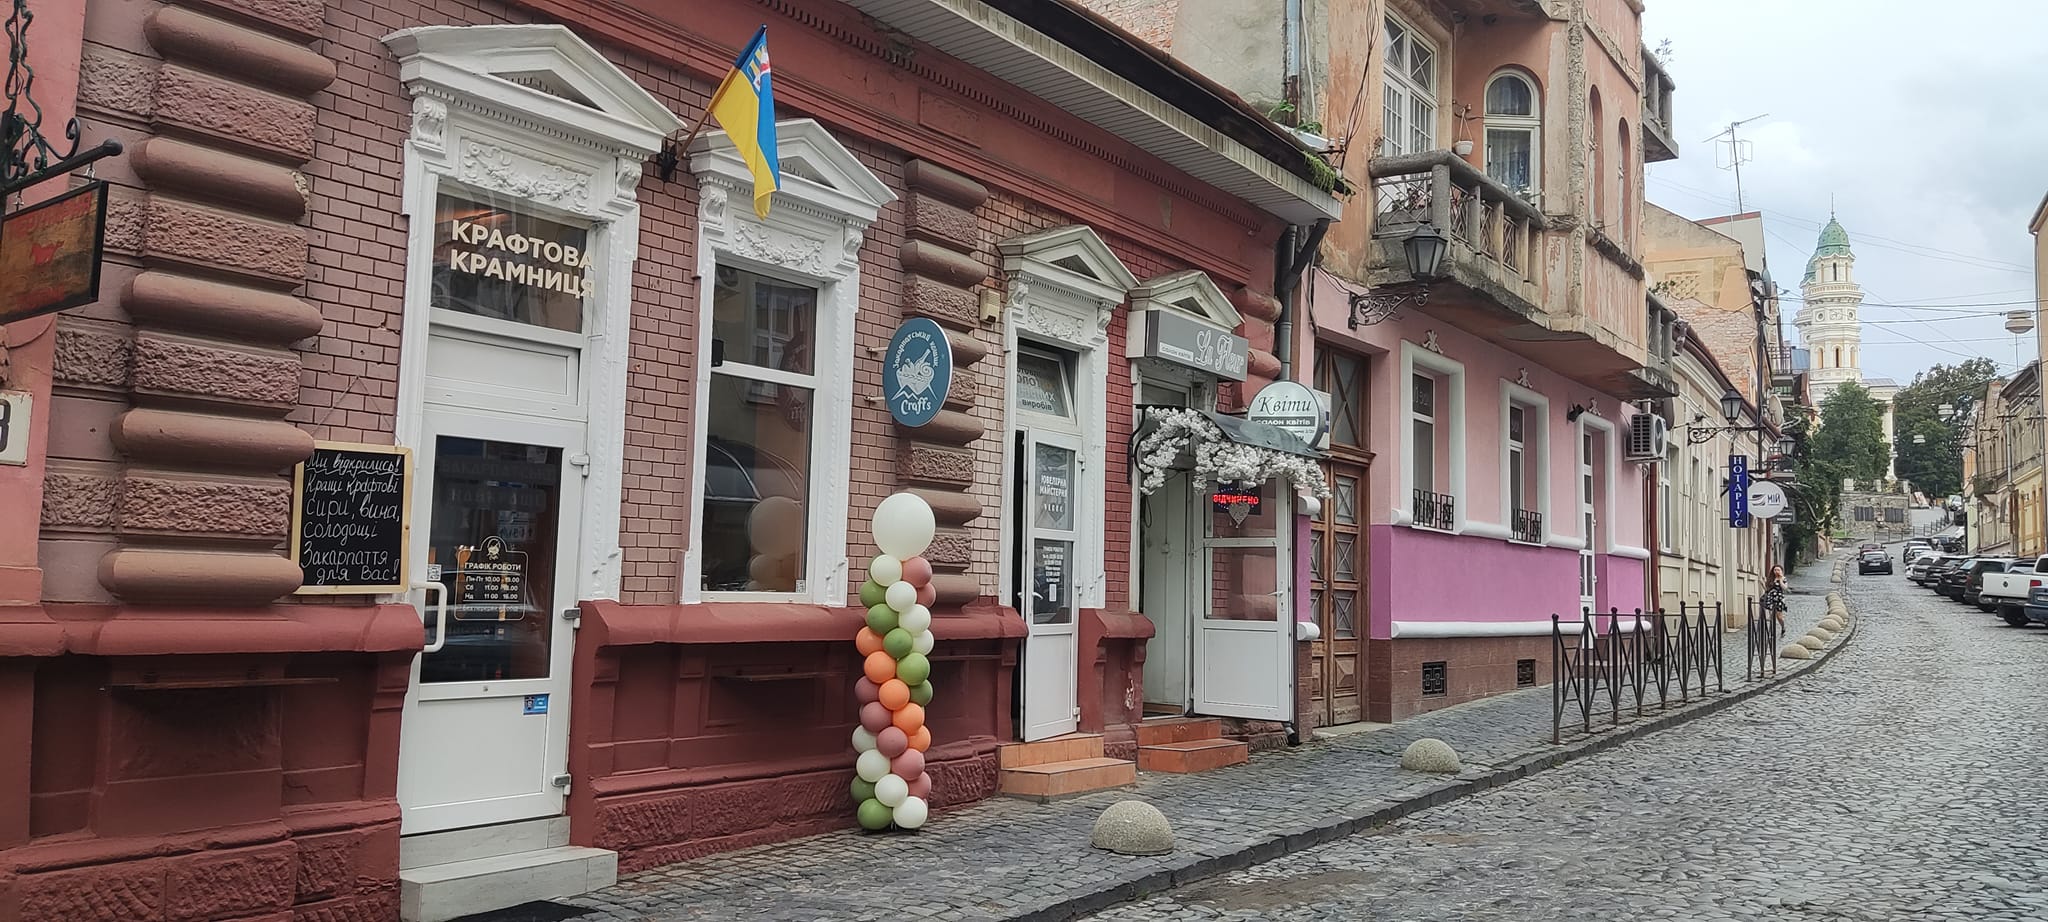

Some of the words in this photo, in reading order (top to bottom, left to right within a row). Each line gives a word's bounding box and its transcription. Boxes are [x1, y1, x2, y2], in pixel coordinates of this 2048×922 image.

[451, 219, 595, 272] КРАФТОВА
[450, 249, 595, 299] КРАМНИЦЯ
[1195, 330, 1214, 366] La
[1214, 334, 1245, 374] Fleur
[901, 397, 932, 415] Crafts
[1258, 395, 1312, 415] Квіти
[305, 452, 328, 468] Ми
[333, 452, 402, 477] відкрились!
[1732, 456, 1743, 527] НОТАРІУС
[359, 493, 400, 522] вина,
[301, 541, 388, 573] Закарпаття
[464, 562, 492, 570] ГРАФІК
[493, 563, 521, 571] РОБОТИ
[316, 567, 350, 585] для
